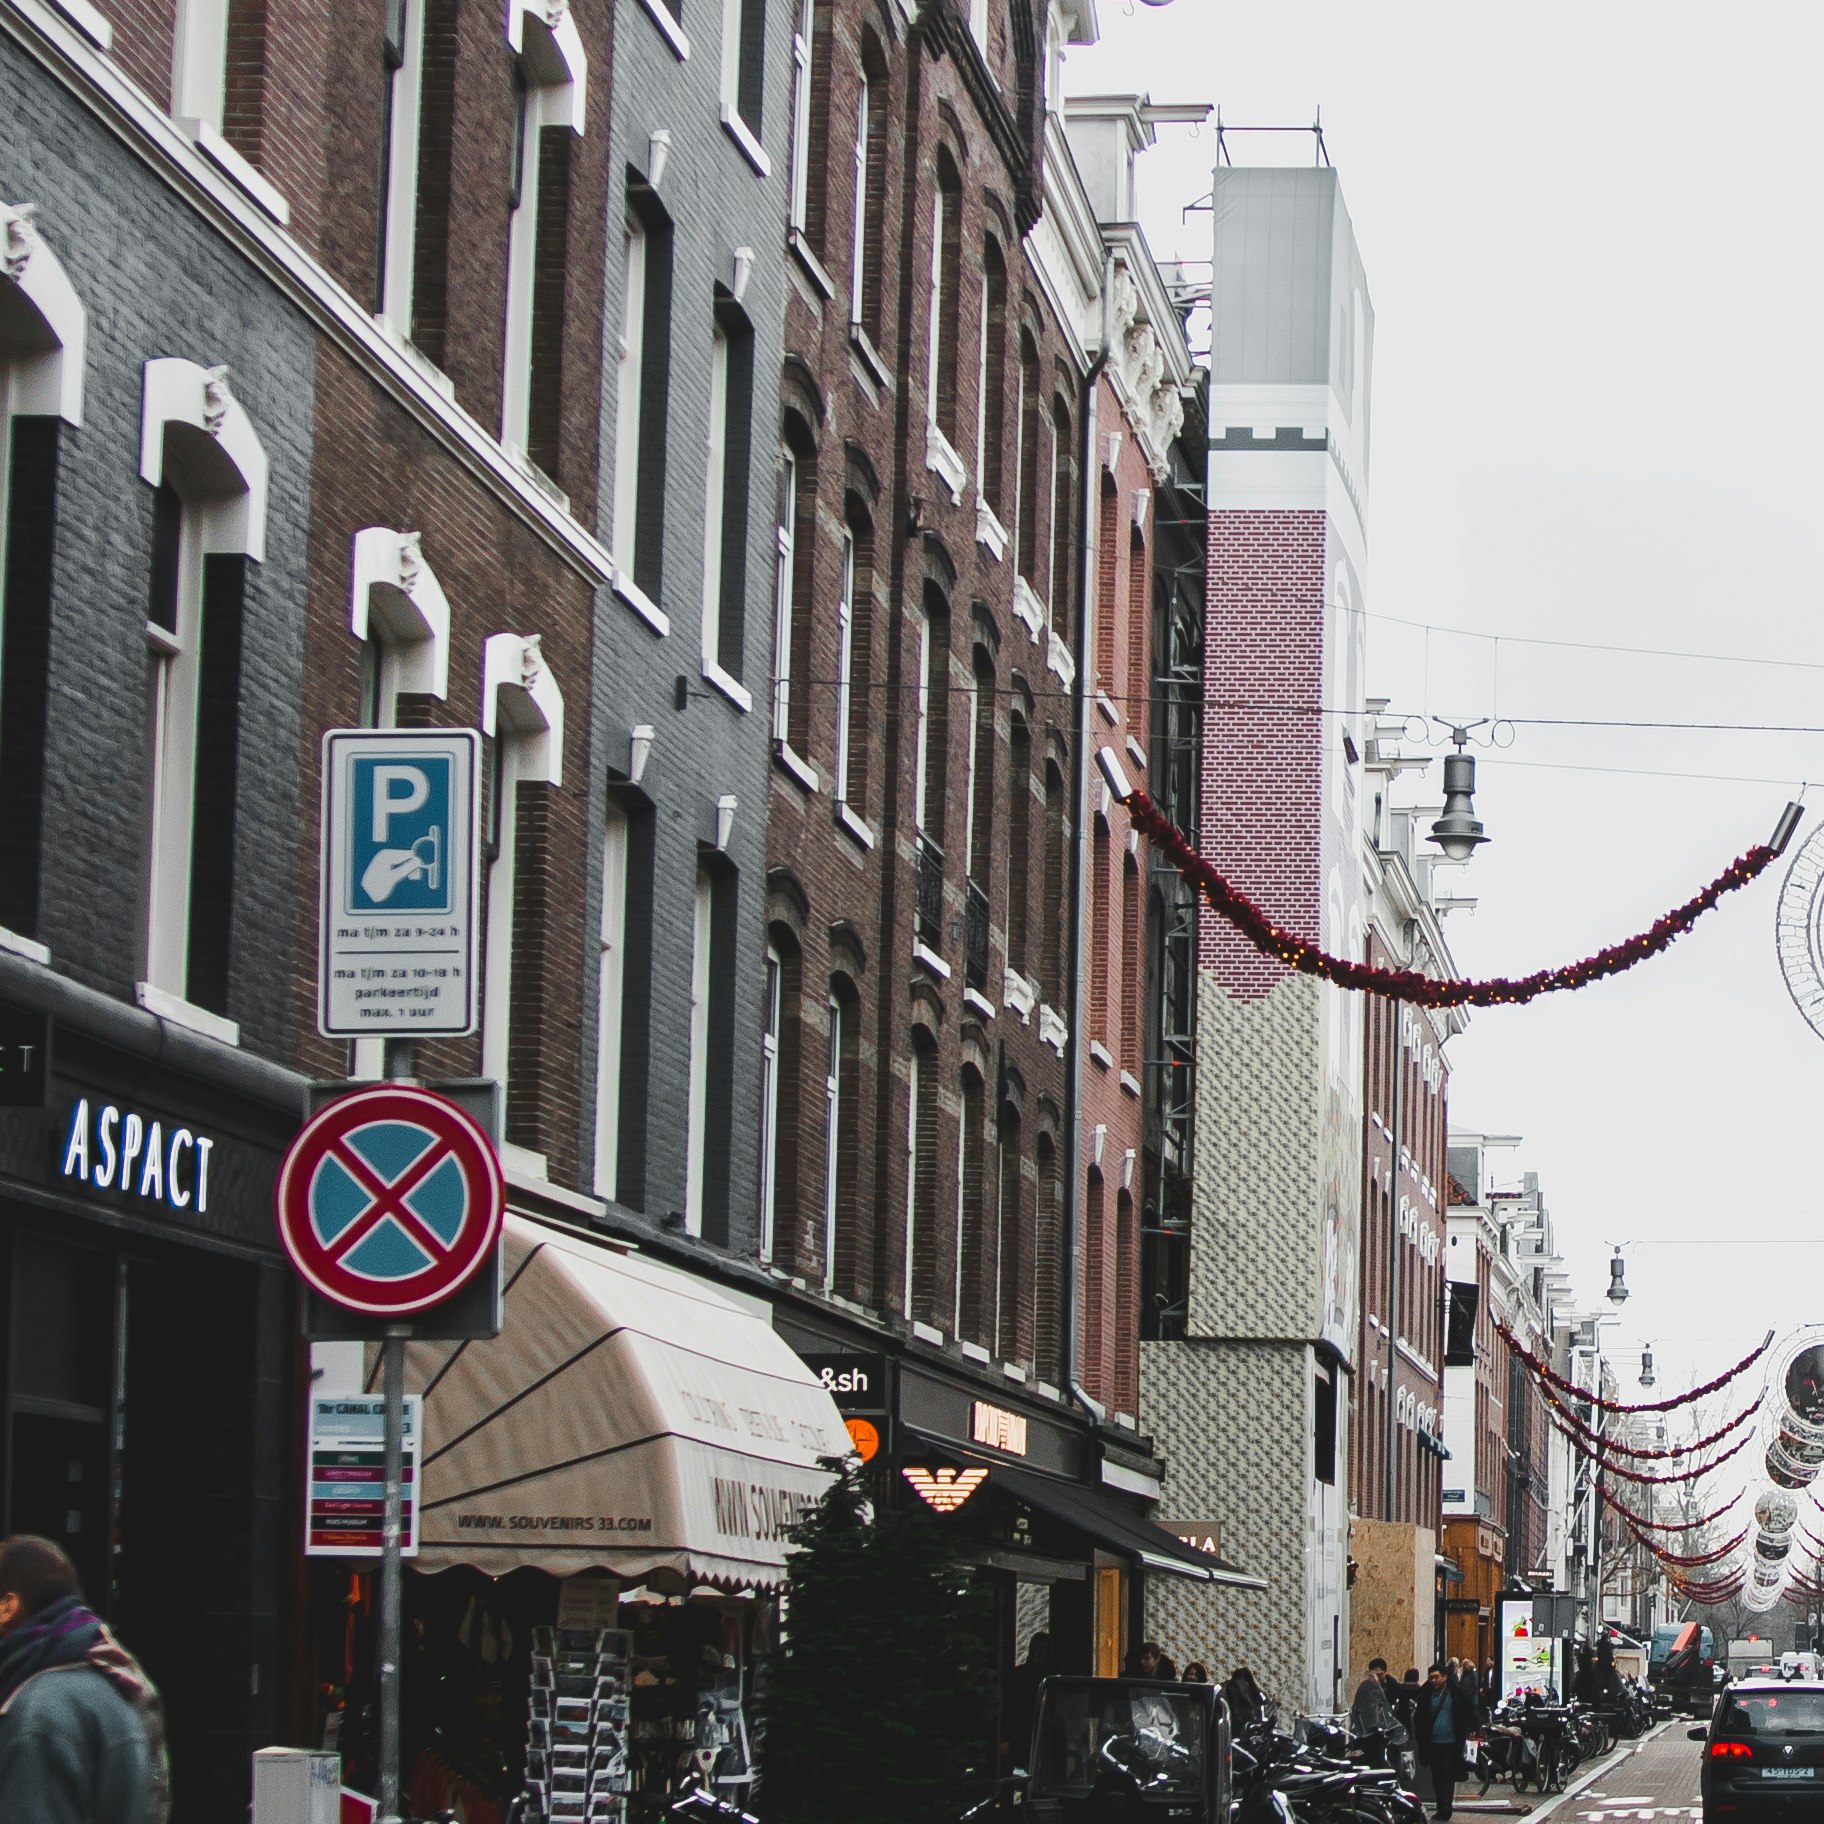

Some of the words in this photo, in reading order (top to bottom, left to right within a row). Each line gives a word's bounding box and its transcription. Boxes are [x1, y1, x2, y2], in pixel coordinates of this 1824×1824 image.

[371, 765, 430, 842] P
[355, 985, 440, 1001] parkeertijd
[409, 1007, 435, 1018] uur
[60, 1098, 214, 1213] ASPACT
[508, 1515, 595, 1532] SOUVENIRS
